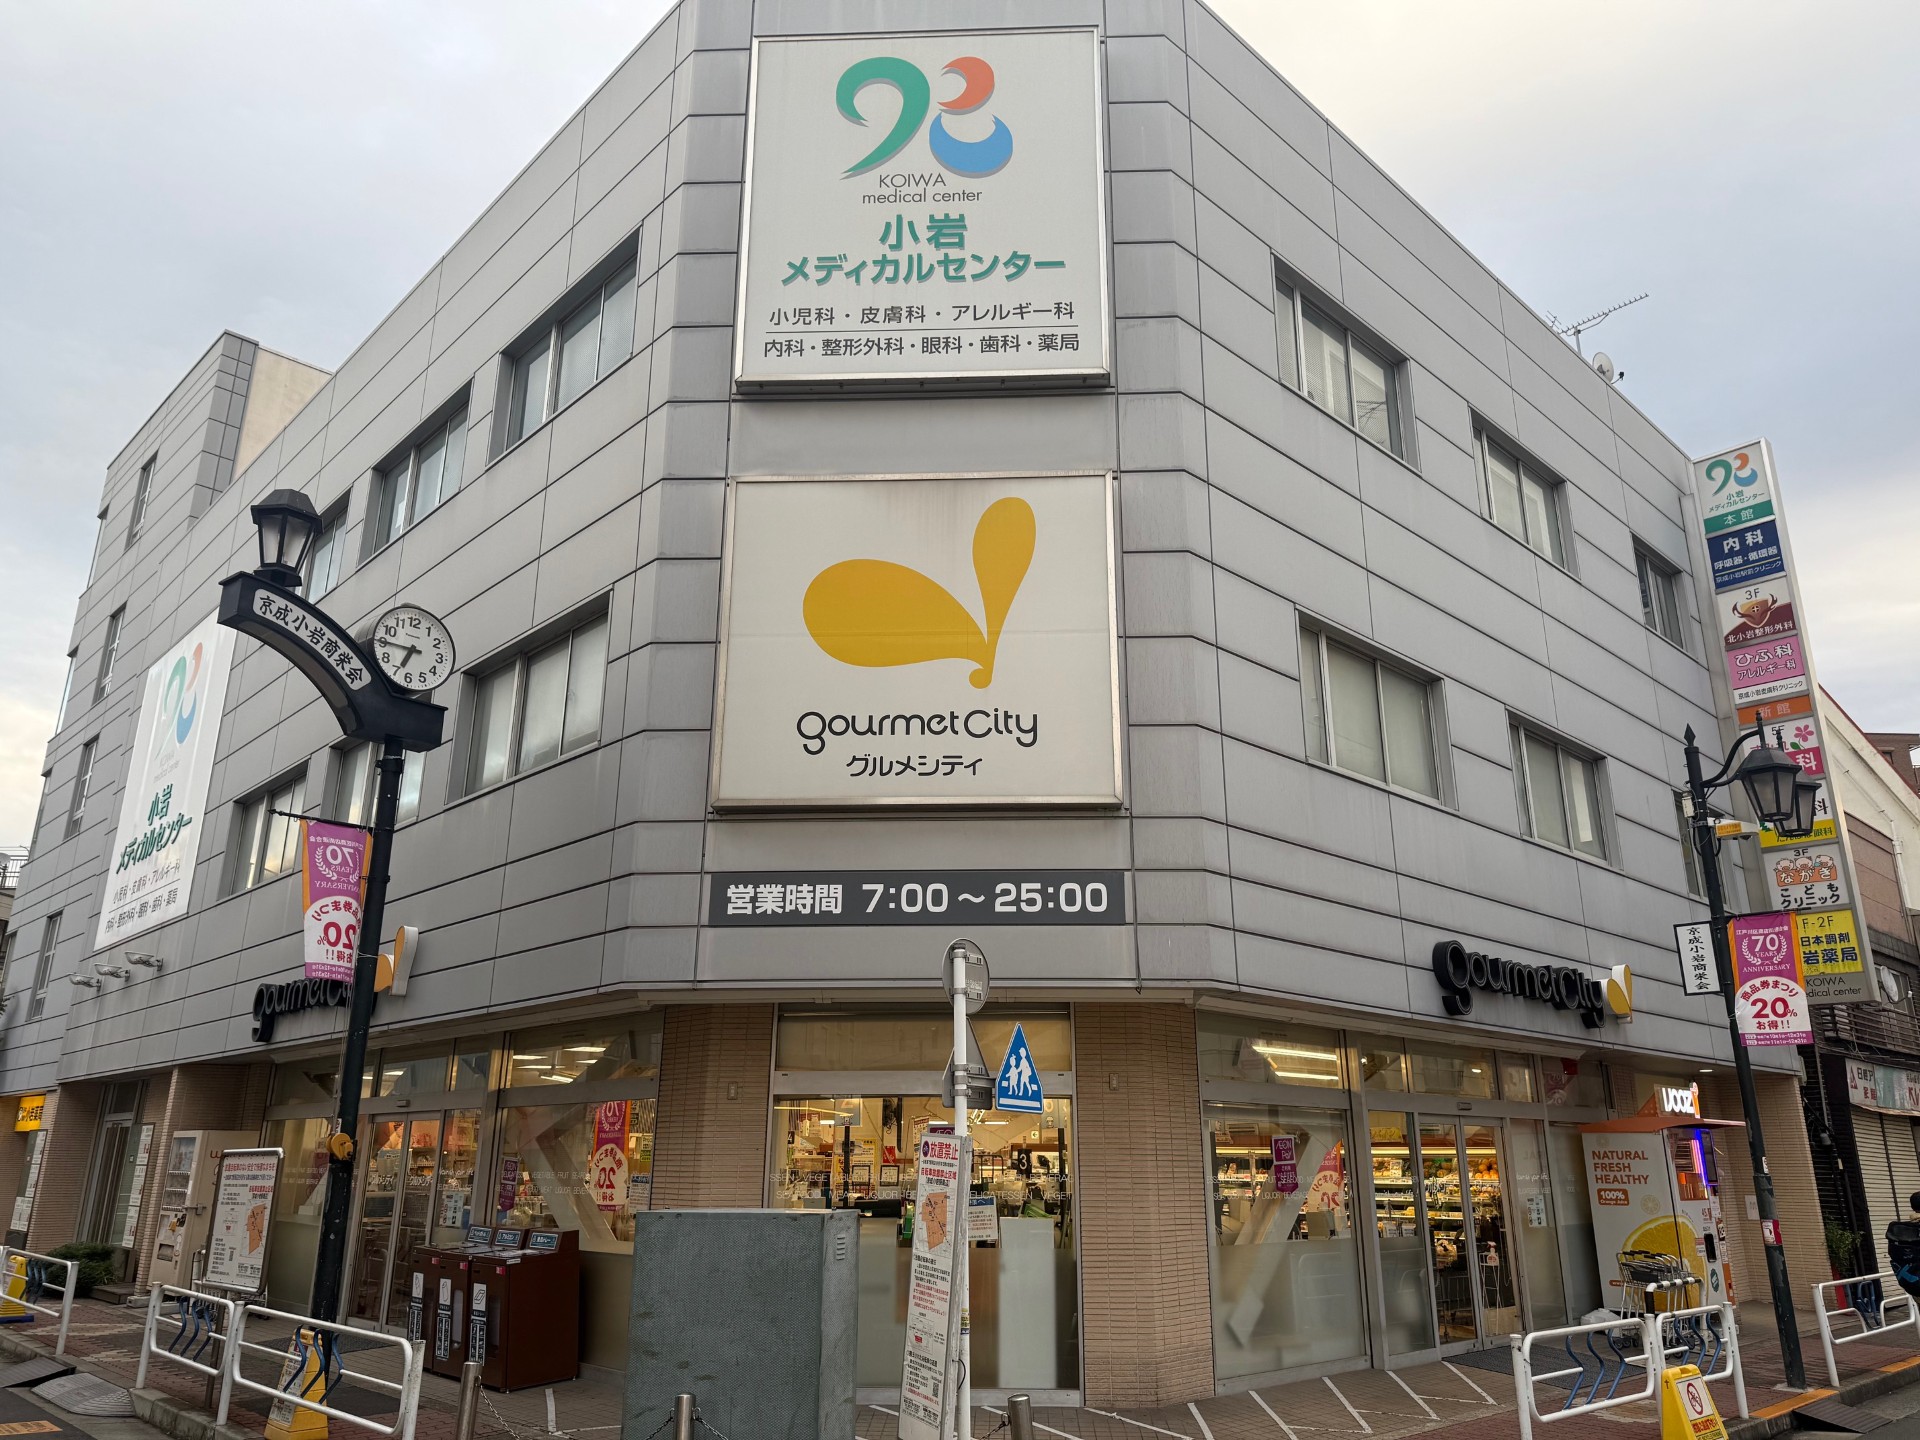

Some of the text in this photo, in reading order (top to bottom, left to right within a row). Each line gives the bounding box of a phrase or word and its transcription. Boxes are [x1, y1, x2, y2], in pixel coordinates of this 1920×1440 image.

[879, 173, 947, 188] KOIWA
[862, 189, 983, 204] medical center
[879, 213, 968, 251] 小岩
[781, 251, 1066, 286] メディカルセンター
[1708, 492, 1765, 513] メディカルセンター
[1726, 489, 1744, 501] 小岩
[1723, 508, 1754, 525] 本館
[1723, 529, 1763, 553] 内科
[1745, 588, 1760, 600] 3F
[394, 616, 406, 629] 11
[407, 616, 422, 630] 12
[383, 624, 397, 638] 10
[425, 626, 432, 637] 1
[1727, 620, 1793, 644] 北小岩整形外科
[259, 595, 364, 686] 京成小岩商栄会
[379, 636, 388, 648] 9
[432, 638, 442, 649] 2
[381, 652, 390, 664] 8
[435, 653, 444, 664] 3
[1735, 643, 1793, 667] ひふ科
[392, 664, 401, 676] 7
[429, 665, 438, 676] 4
[1738, 659, 1796, 680] アレルギー科
[404, 672, 413, 684] 6
[418, 672, 427, 683] 5
[1759, 702, 1791, 718] 新館
[846, 753, 983, 777] グルメシティ
[148, 783, 173, 826] 小岩
[116, 812, 193, 875] メディカルセンター
[1793, 848, 1809, 857] 3F
[1780, 882, 1839, 898] こども
[726, 884, 843, 915] 営業時間
[1781, 893, 1840, 909] クリニック
[1797, 915, 1834, 930] F-2F
[1751, 934, 1779, 952] 70
[1800, 932, 1851, 947] 日本調剤
[1687, 927, 1711, 990] 京成小岩商栄会
[1803, 947, 1858, 965] 岩薬局
[1742, 963, 1791, 973] ANNIVERSARY
[1806, 976, 1845, 987] KOIWA
[1740, 979, 1799, 1002] 商品券まつり
[1833, 987, 1862, 997] center
[930, 1141, 959, 1160] 放置禁止
[1591, 1150, 1649, 1161] NATURAL
[1019, 1154, 1028, 1170] 3
[1593, 1162, 1631, 1173] FRESH
[1595, 1174, 1650, 1185] HEALTHY
[970, 1191, 1033, 1200] ELICATESSEN
[1600, 1190, 1625, 1200] 100%
